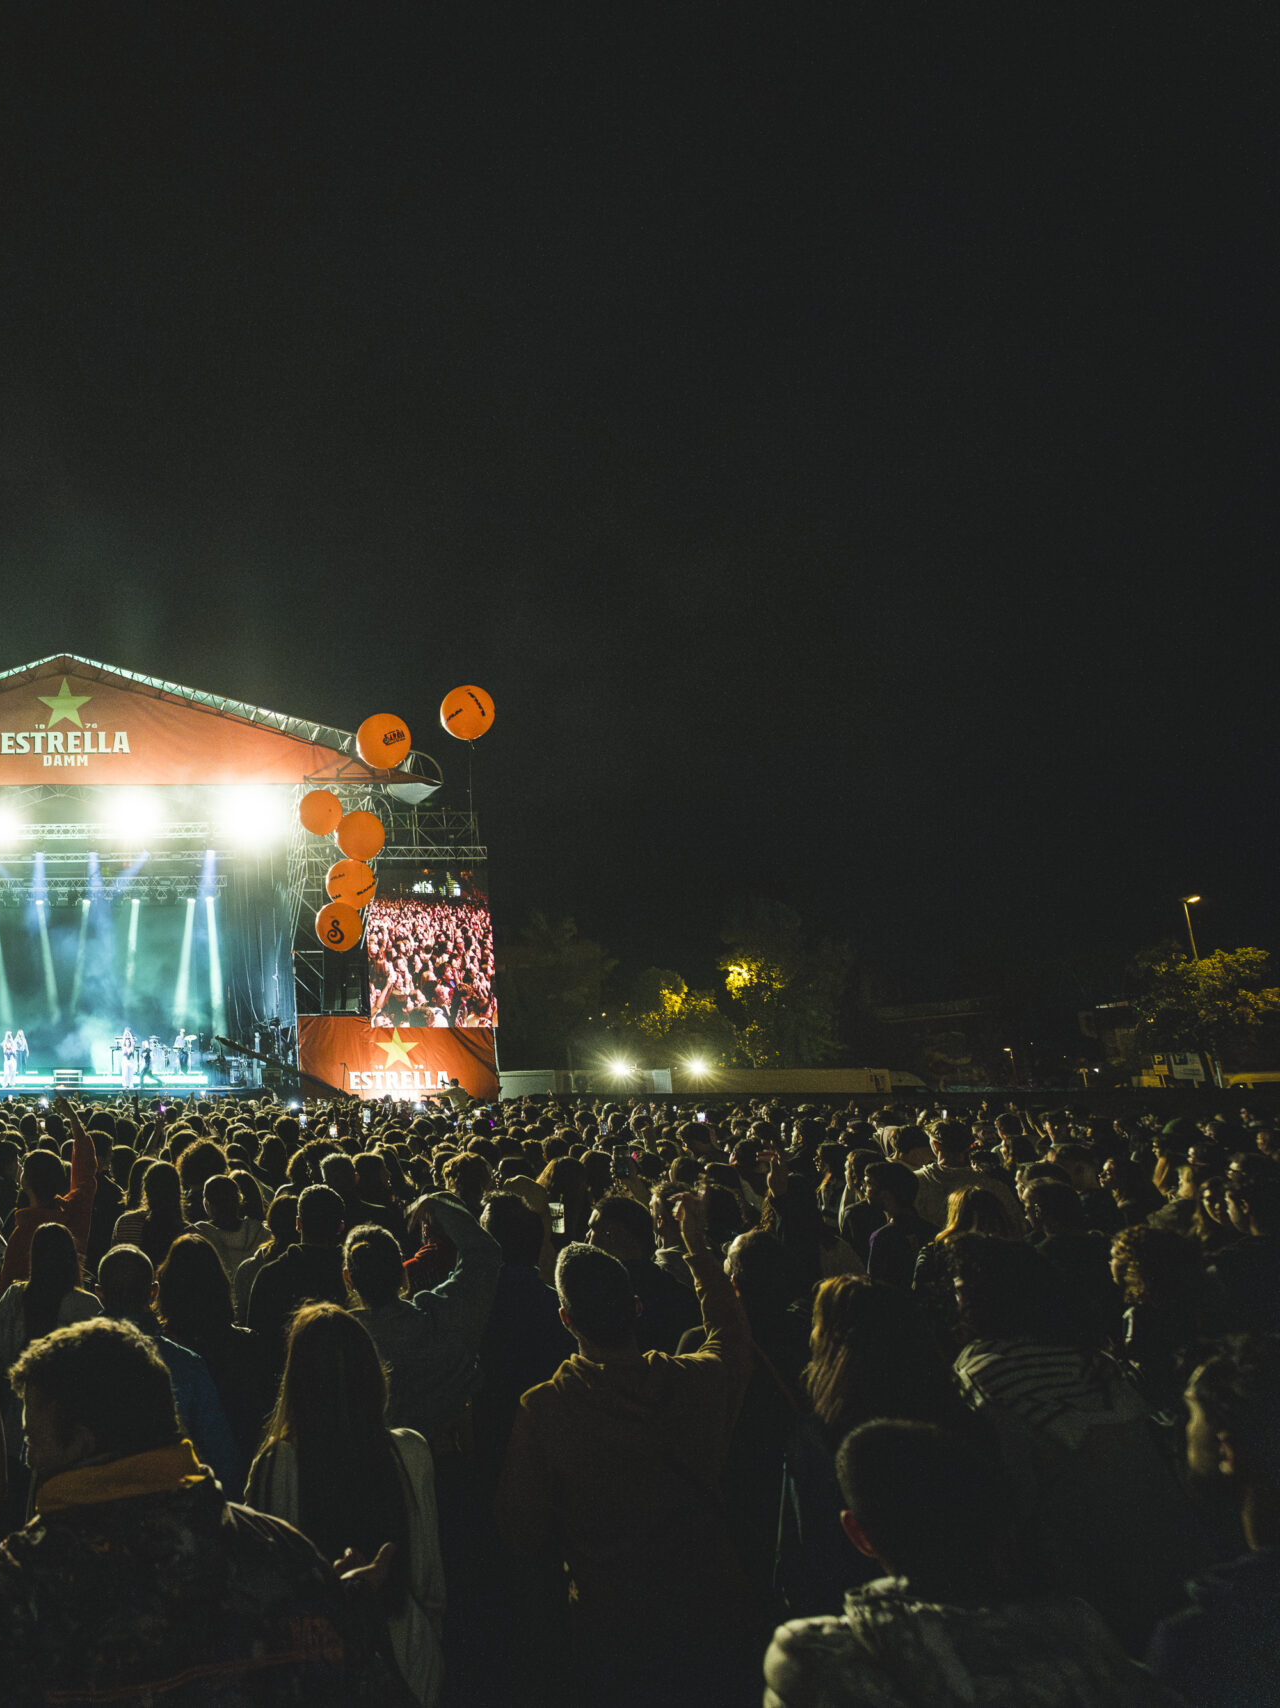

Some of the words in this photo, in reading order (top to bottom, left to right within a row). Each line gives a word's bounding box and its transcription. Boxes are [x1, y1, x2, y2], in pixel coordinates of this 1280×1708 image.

[0, 731, 130, 755] ESTRELLA
[43, 754, 88, 767] DAMM
[1153, 1053, 1164, 1065] P
[349, 1071, 450, 1090] ESTRELLA
